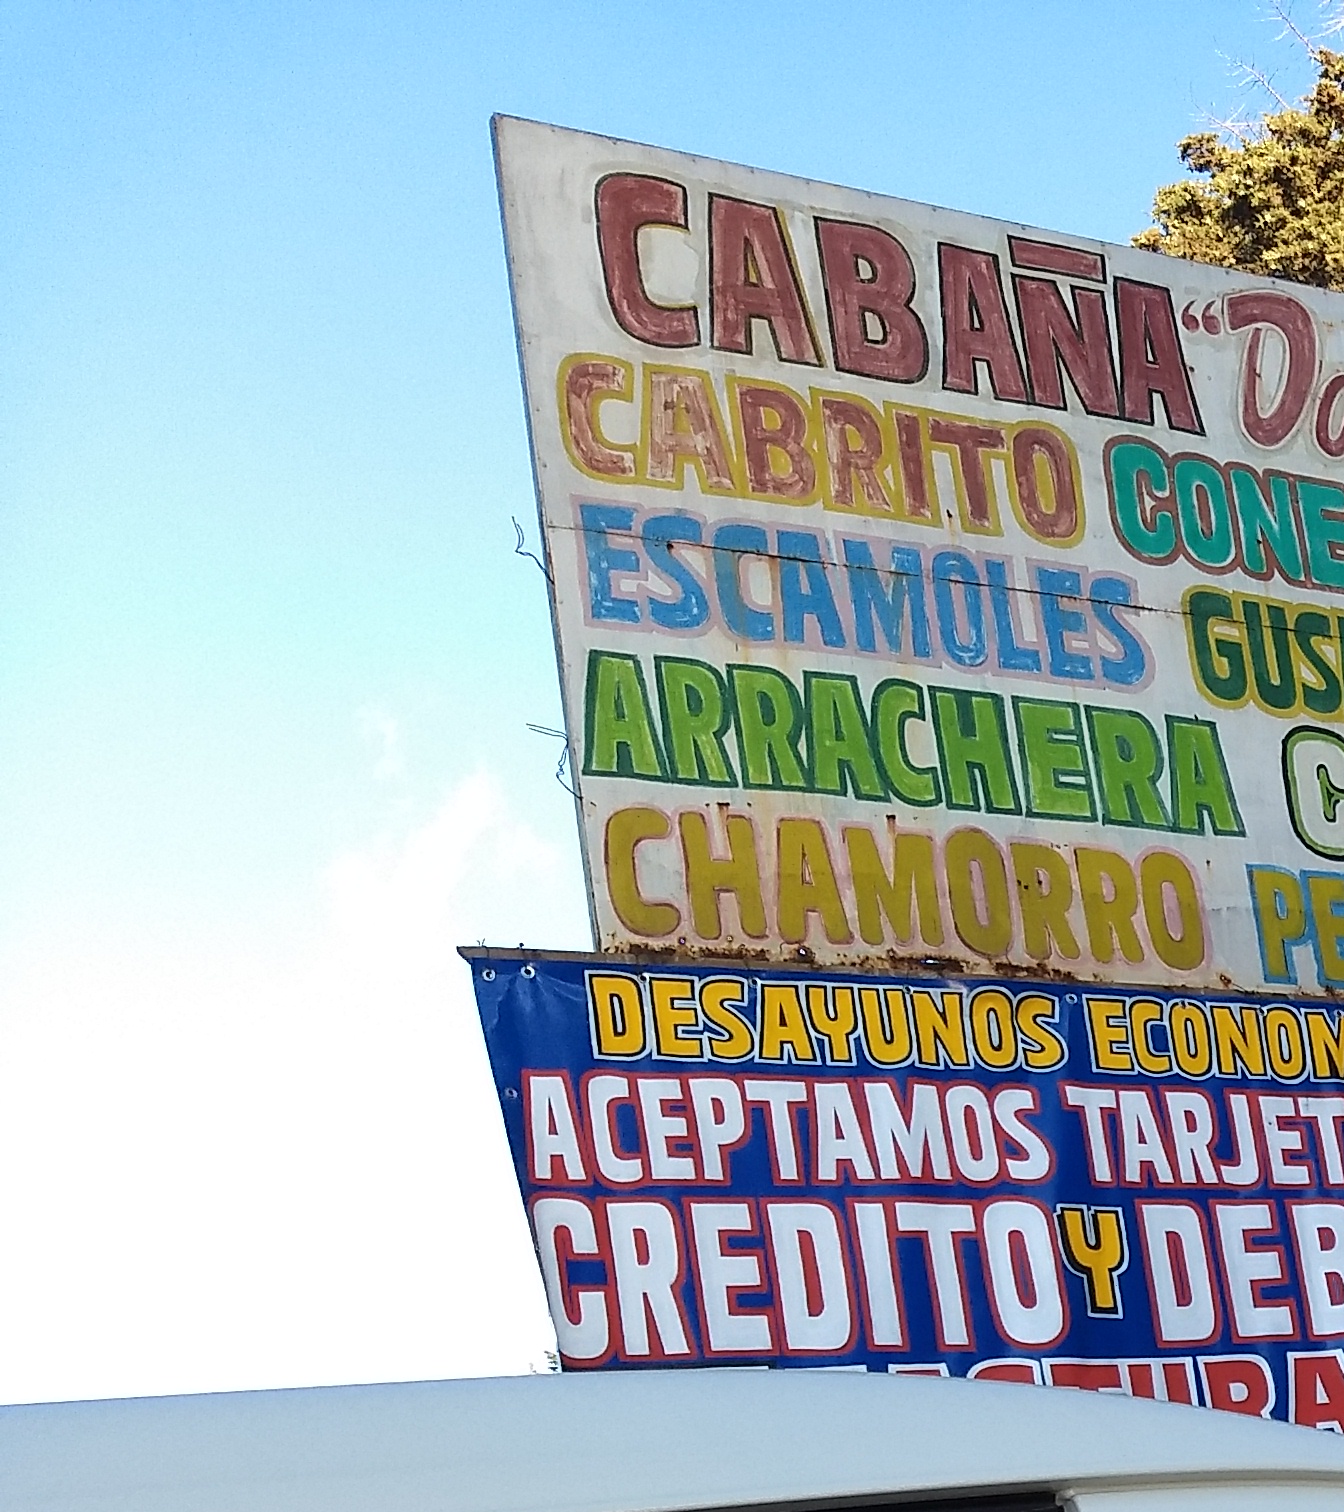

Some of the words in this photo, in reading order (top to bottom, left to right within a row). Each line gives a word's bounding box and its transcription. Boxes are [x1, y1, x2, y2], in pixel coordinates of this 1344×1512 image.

[594, 171, 1206, 436] CABAÑA
[557, 352, 1087, 549] CABRITO
[570, 494, 1157, 694] ESCAMOLES
[582, 650, 1247, 838] ARRACHERA
[601, 805, 1211, 973] CHAMORRO
[586, 969, 1068, 1070] DESAYUNOS
[522, 1069, 1056, 1187] ACEPTAMOS
[530, 1195, 1070, 1369] CREDITO
[1056, 1204, 1128, 1318] Y
